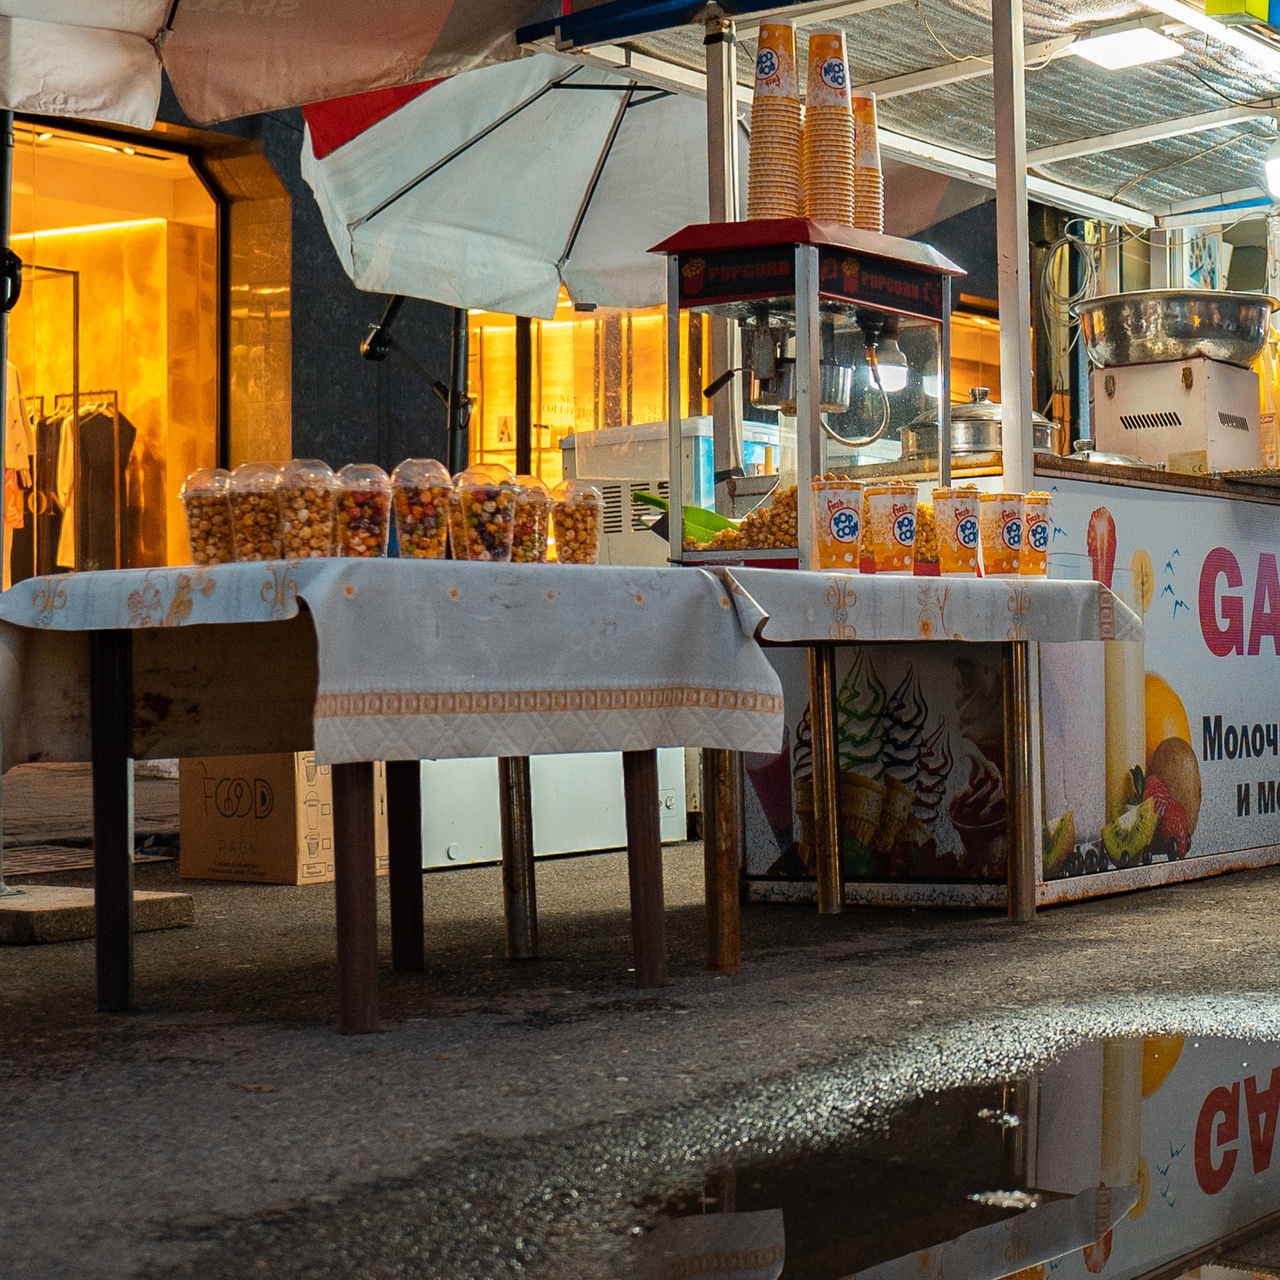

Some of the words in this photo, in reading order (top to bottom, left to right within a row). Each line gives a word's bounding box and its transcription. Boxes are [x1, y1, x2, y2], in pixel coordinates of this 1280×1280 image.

[708, 259, 790, 280] POPCORN
[861, 271, 920, 296] POPCORN
[833, 513, 854, 528] POP
[897, 516, 914, 531] POP
[960, 519, 978, 534] POP
[1005, 522, 1022, 536] POP
[1031, 524, 1047, 538] POP
[199, 776, 274, 819] FOOD
[1236, 785, 1251, 817] и
[219, 839, 257, 857] PACK
